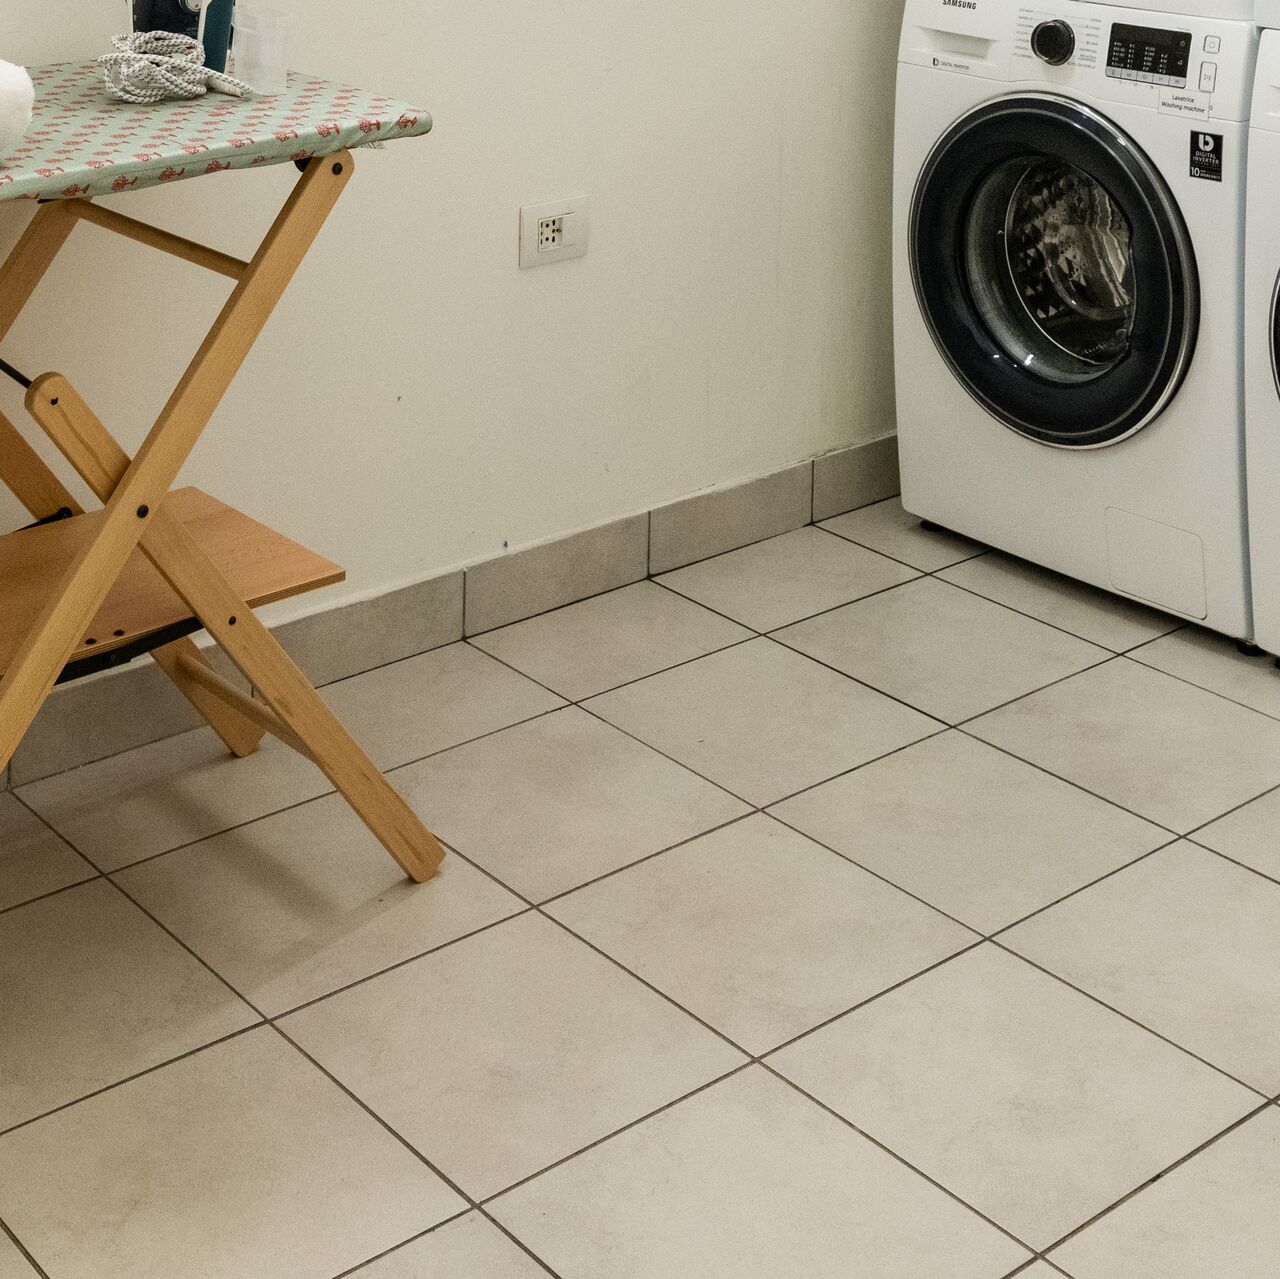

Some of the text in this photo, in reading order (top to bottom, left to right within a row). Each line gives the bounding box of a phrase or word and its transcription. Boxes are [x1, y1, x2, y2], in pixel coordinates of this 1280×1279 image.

[1172, 94, 1195, 103] Lavatrice
[1161, 100, 1205, 114] Washing machine
[1195, 150, 1216, 159] DIGITAL
[1192, 155, 1219, 164] INVERTER
[1191, 166, 1200, 177] 10
